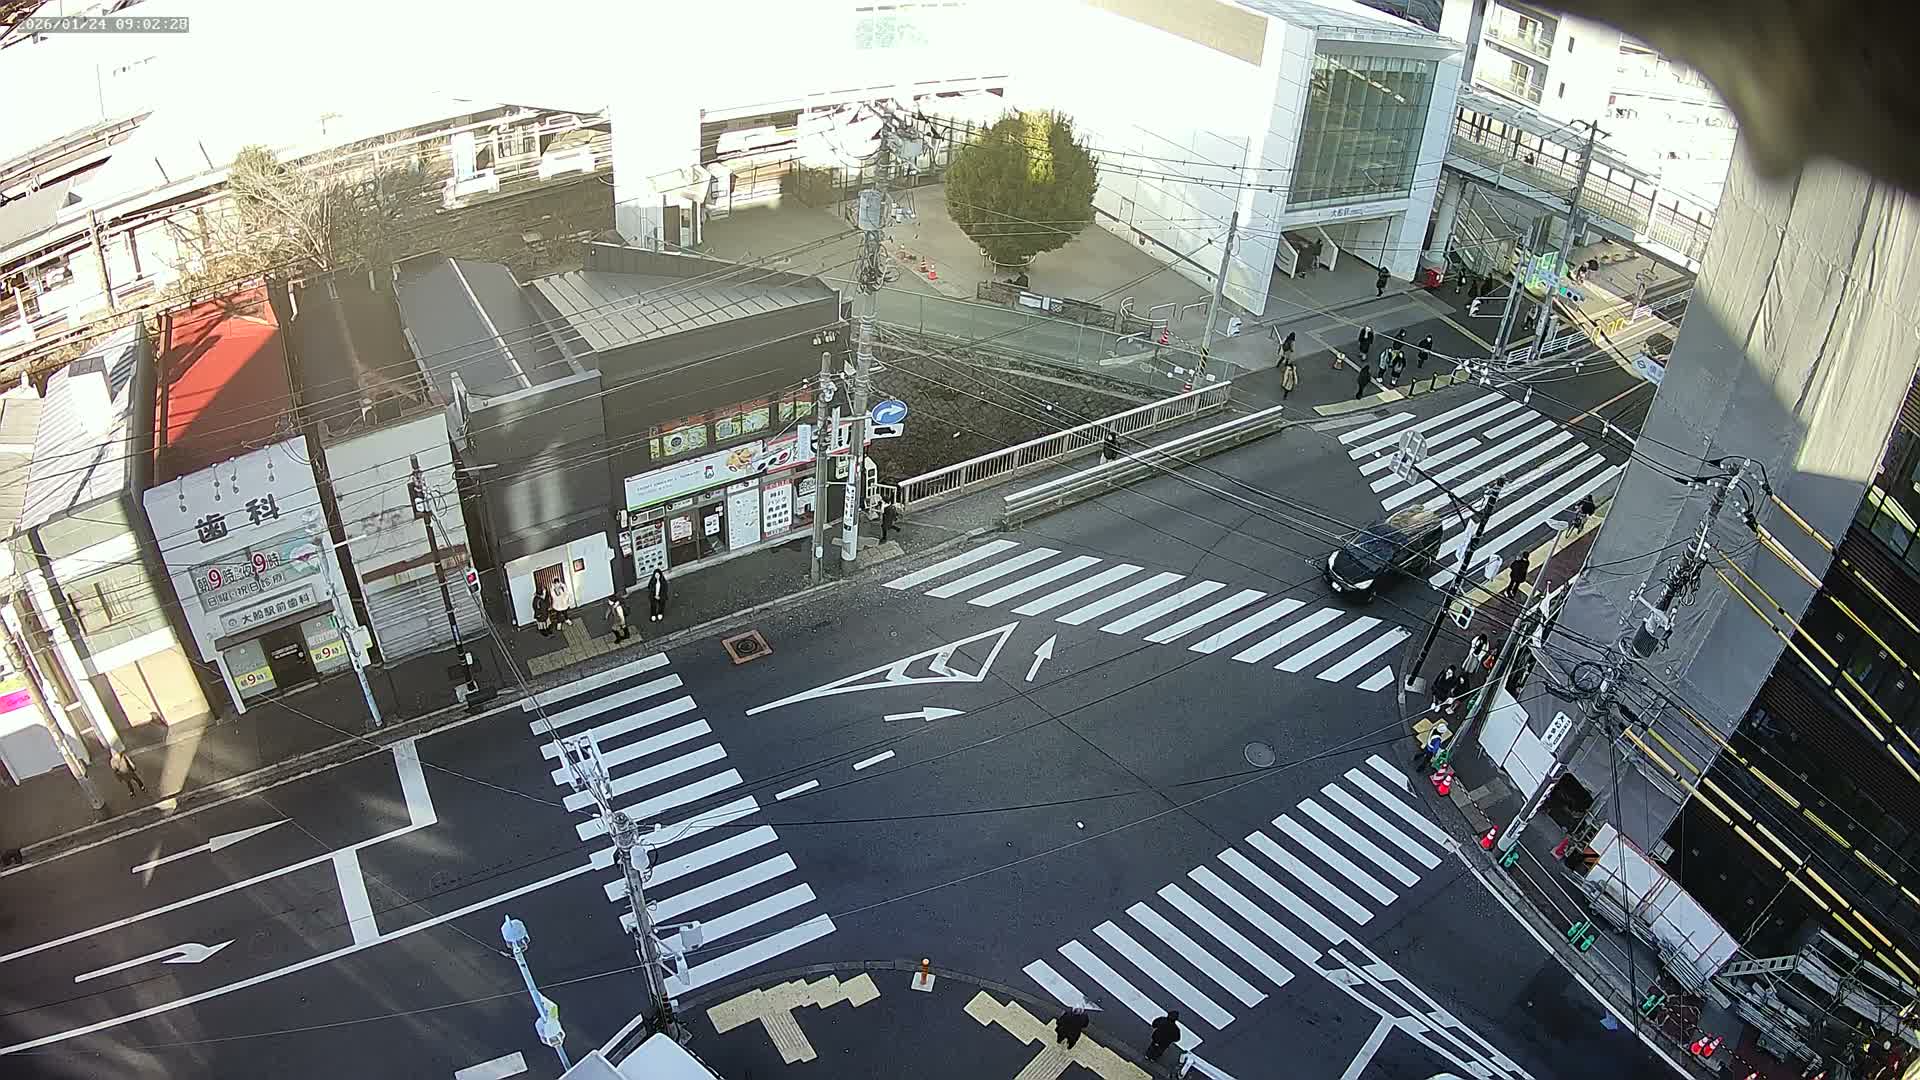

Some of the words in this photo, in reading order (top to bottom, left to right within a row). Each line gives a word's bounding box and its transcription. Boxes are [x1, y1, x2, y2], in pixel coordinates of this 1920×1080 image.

[241, 593, 310, 625] 大船駅前歯科
